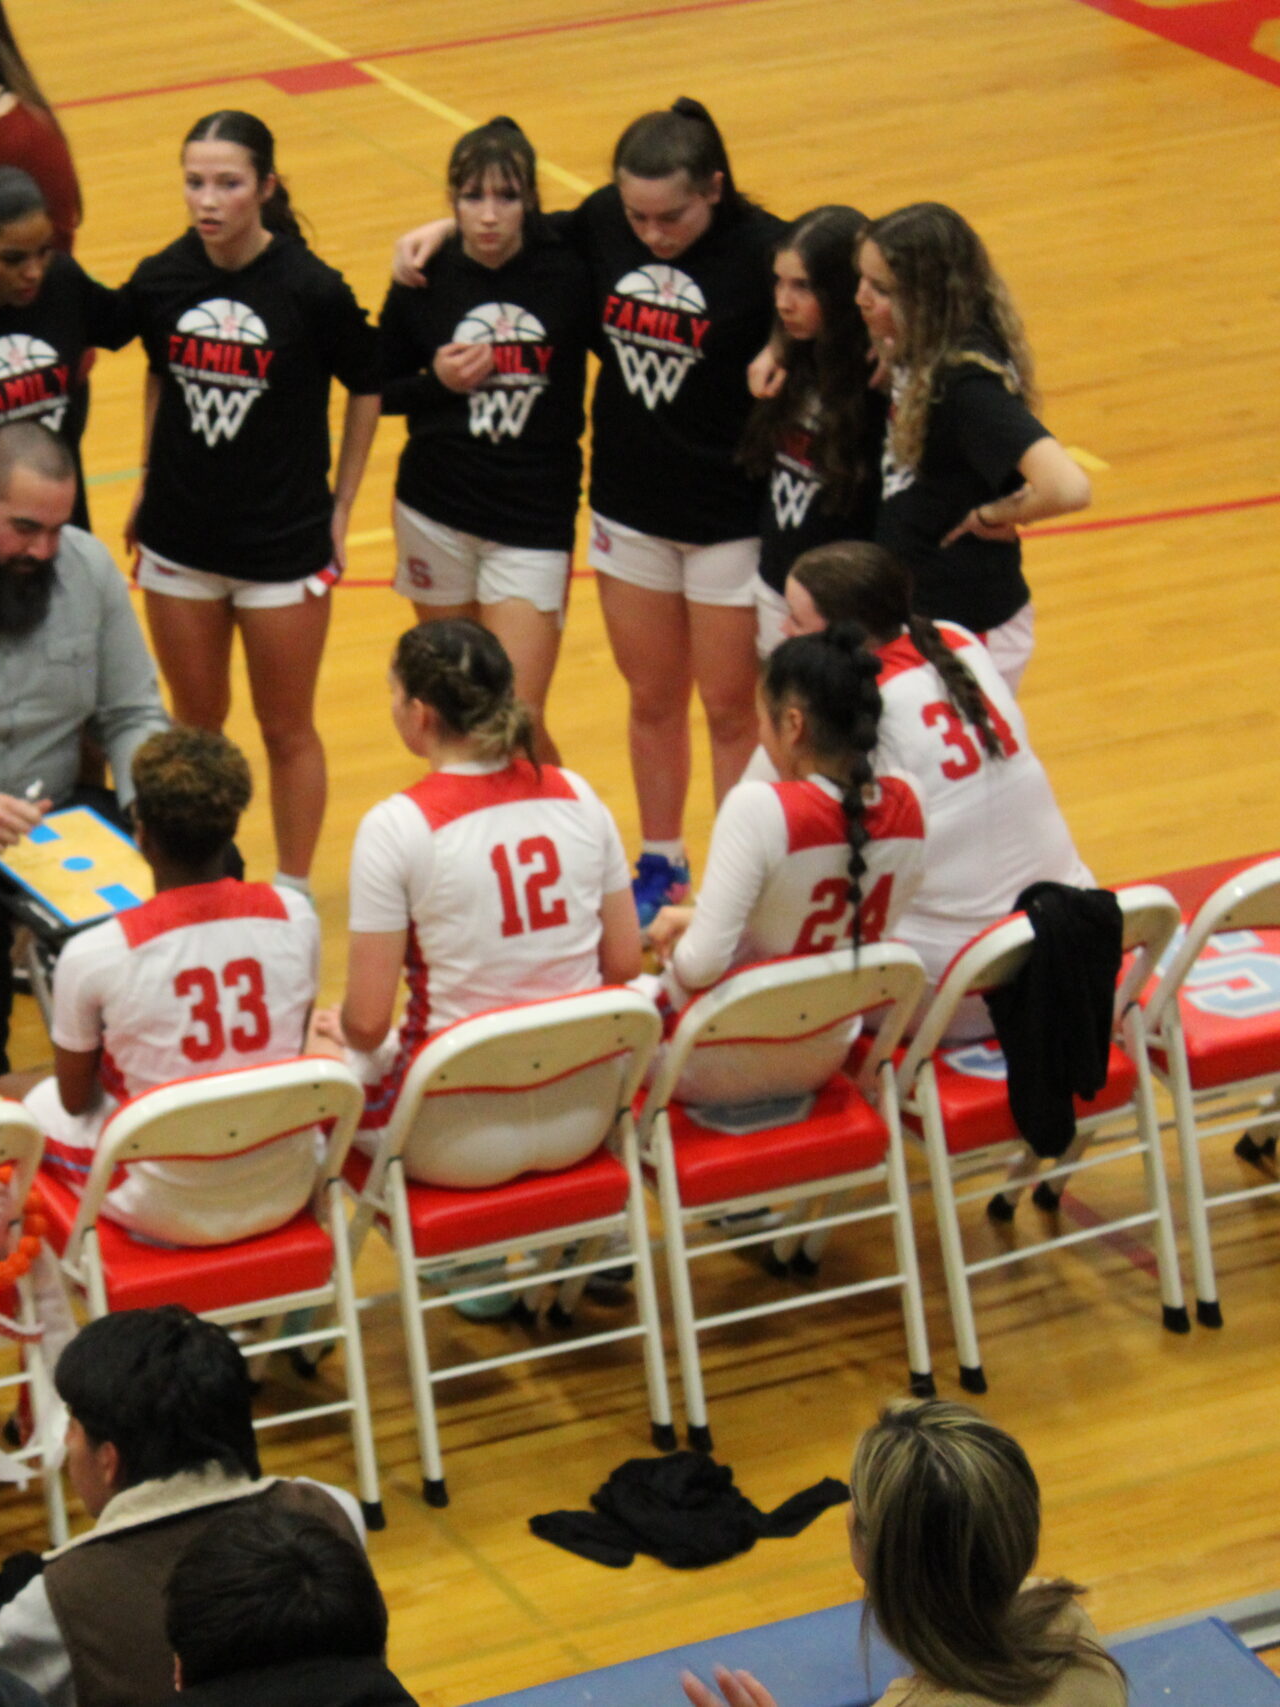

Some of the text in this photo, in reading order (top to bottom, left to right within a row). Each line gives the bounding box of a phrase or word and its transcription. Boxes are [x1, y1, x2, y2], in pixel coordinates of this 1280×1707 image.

[603, 294, 711, 348] FAMILY
[169, 335, 274, 379] FAMILY
[407, 556, 433, 589] S
[490, 834, 568, 938] 12
[790, 871, 895, 955] 24
[174, 957, 272, 1062] 33
